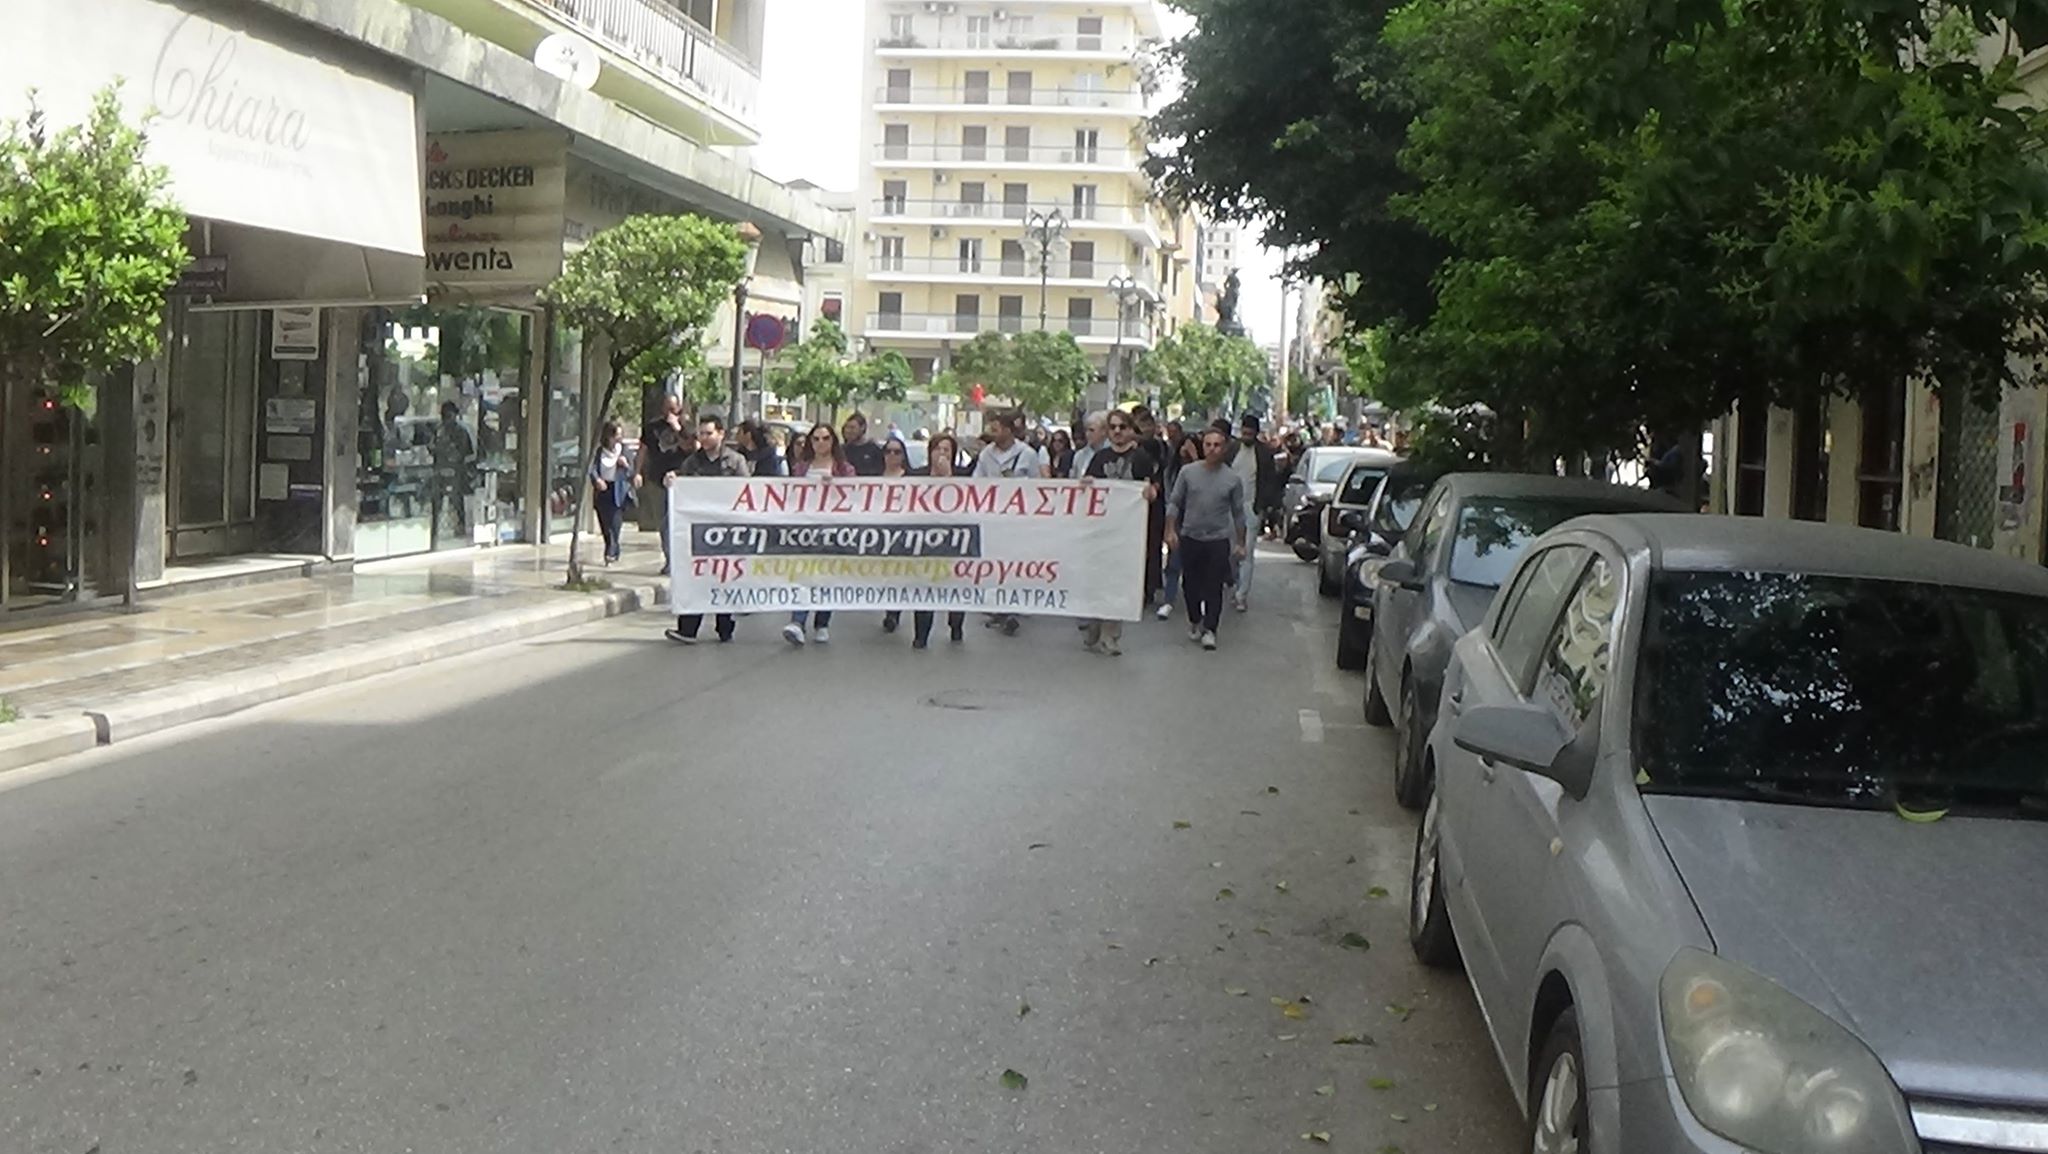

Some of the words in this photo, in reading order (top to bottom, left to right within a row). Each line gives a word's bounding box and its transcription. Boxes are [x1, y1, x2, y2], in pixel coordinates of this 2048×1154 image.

[152, 9, 311, 150] Chiara
[732, 482, 1111, 518] ΑΝΤΙΣΤΕΚΟΜΑΣΤΕ
[704, 526, 768, 554] στη
[779, 526, 972, 556] καταργηση
[692, 557, 747, 583] της
[953, 559, 1060, 585] αργιας
[710, 587, 801, 606] ΣΥΛΛΟΓΟΣ
[810, 586, 986, 605] ΕΜΠΟΡΟΥΠΑΛΛΗΛΩΝ
[995, 587, 1069, 609] ΠΑΤΡΑΣ
